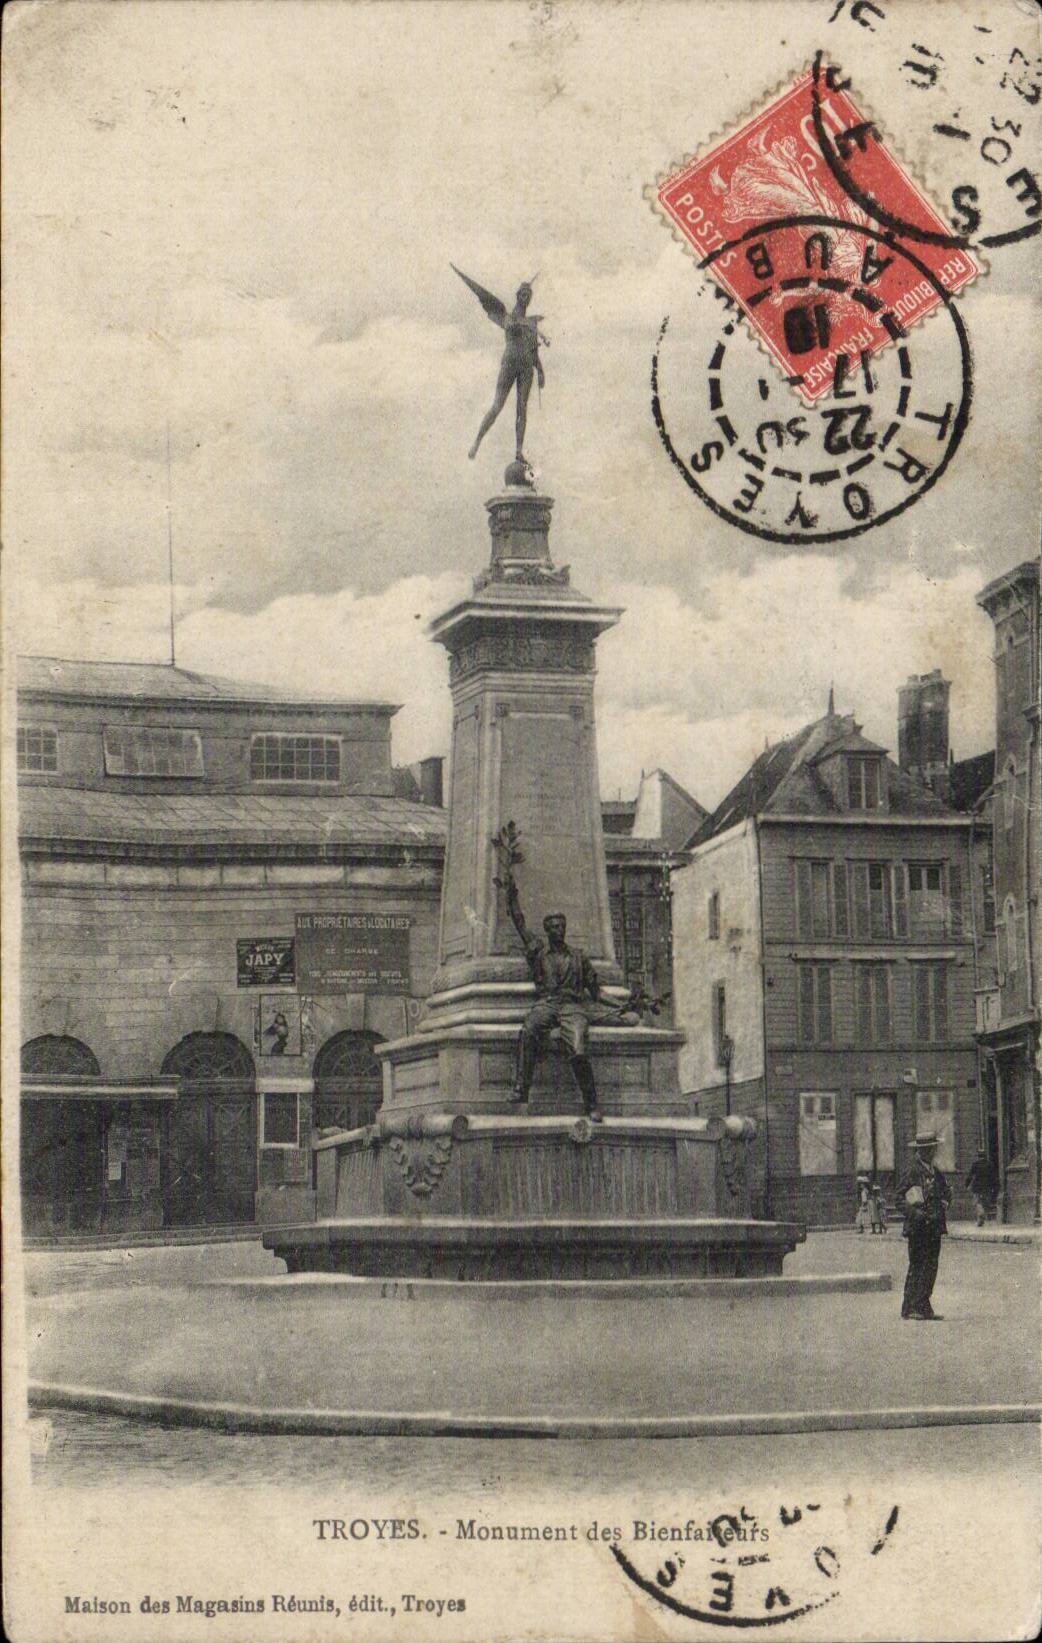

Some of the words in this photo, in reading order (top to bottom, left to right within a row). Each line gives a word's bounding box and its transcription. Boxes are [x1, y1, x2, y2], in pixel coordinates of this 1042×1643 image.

[890, 256, 968, 323] REPBLIQUE
[690, 402, 955, 528] TROYES
[245, 953, 285, 966] JAPY
